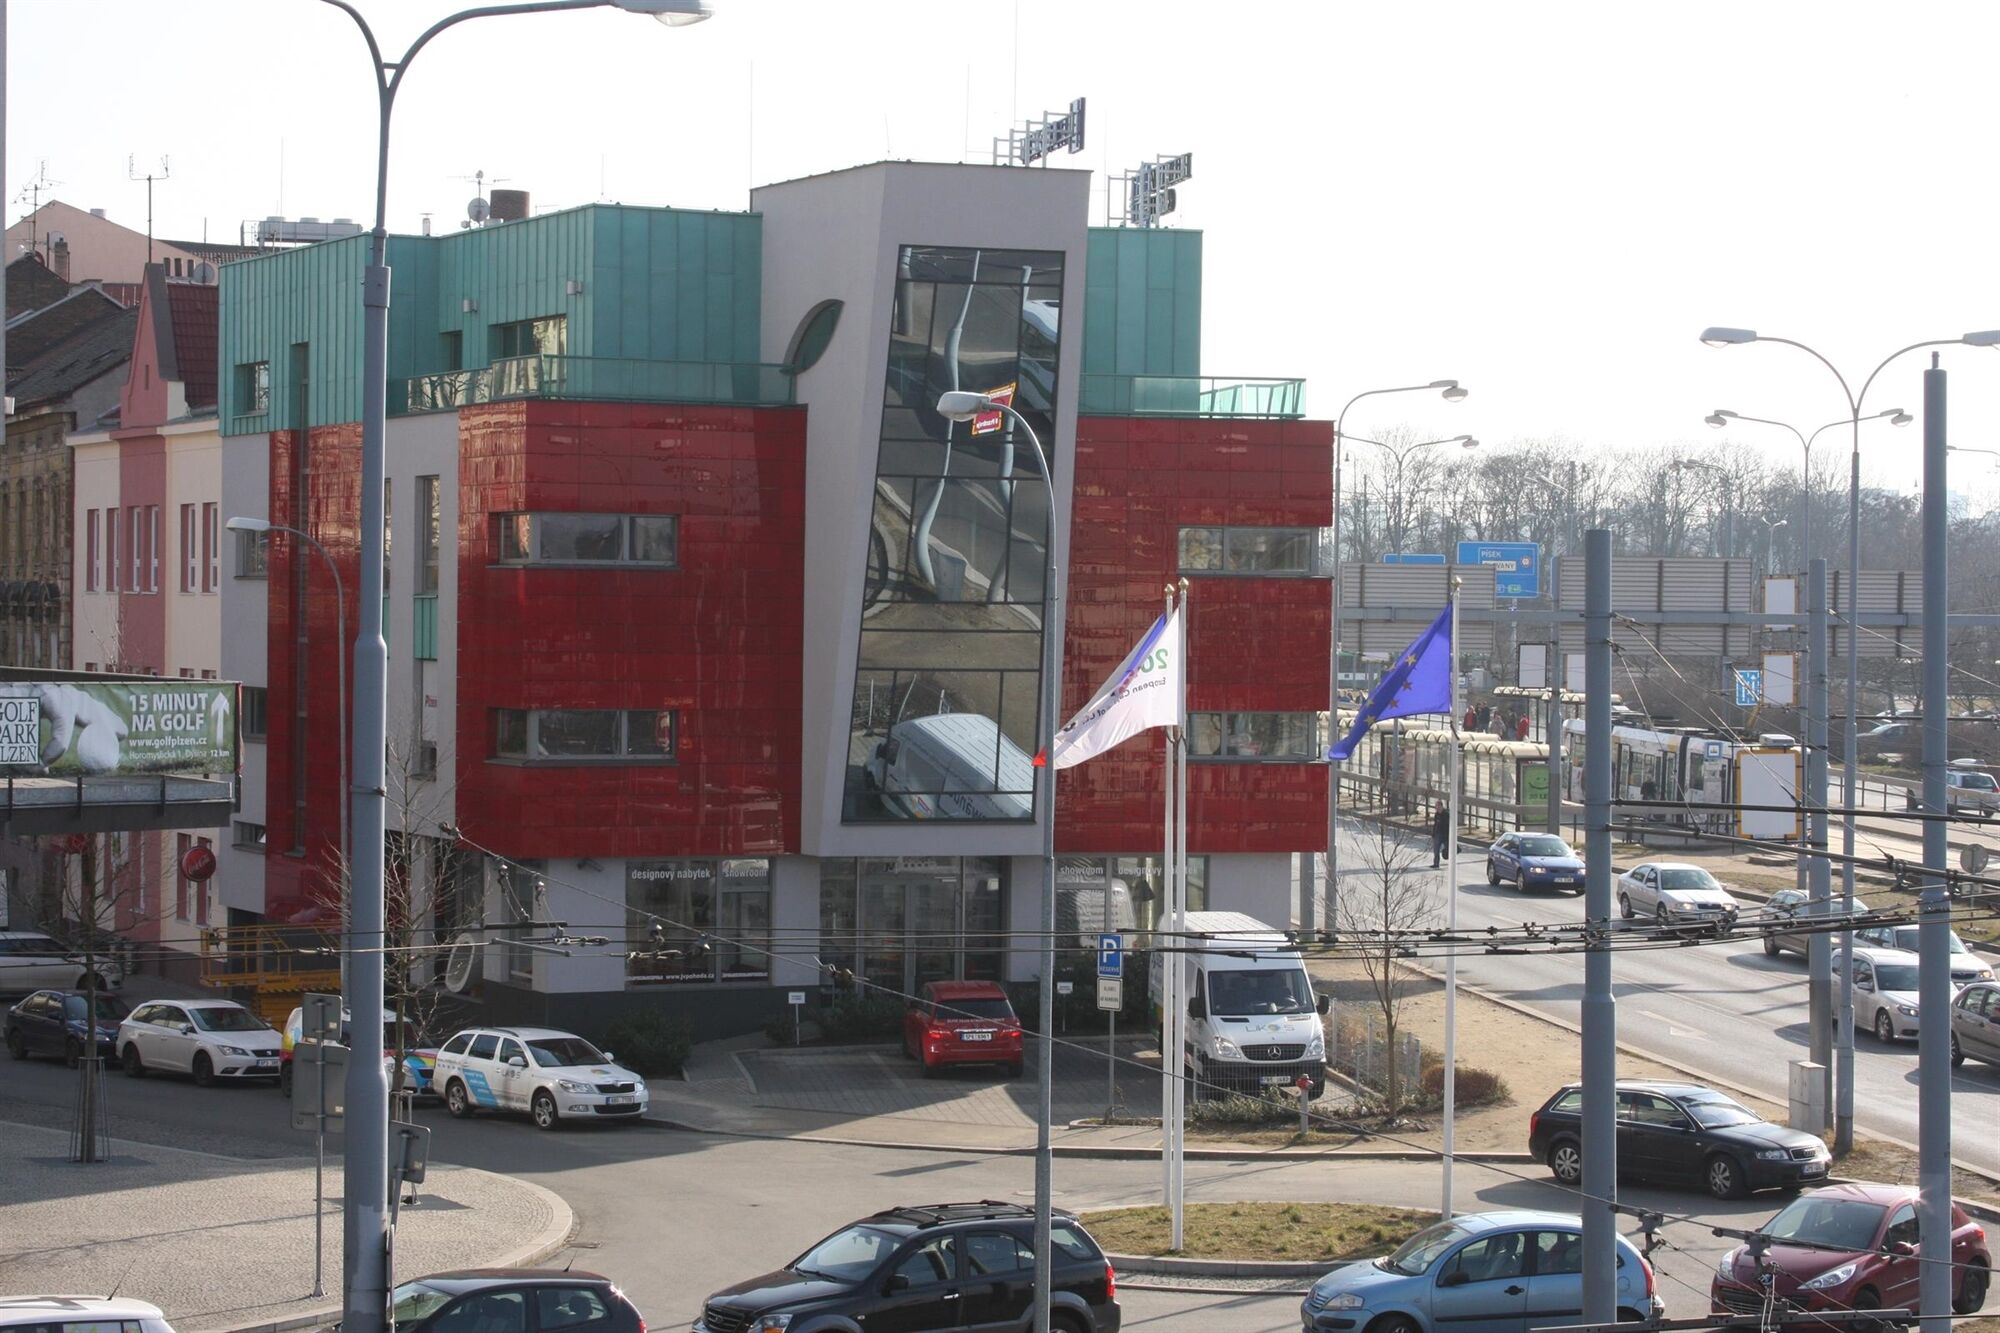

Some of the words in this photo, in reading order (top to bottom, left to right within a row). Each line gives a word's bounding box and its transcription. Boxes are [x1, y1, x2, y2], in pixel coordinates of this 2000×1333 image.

[129, 694, 148, 712] 15
[153, 693, 208, 711] MINUT
[132, 714, 156, 732] NA
[160, 713, 204, 731] GOLF
[0, 724, 36, 744] ARK
[129, 736, 207, 748] www.golfplzen.cz
[1060, 865, 1103, 875] showroom
[1103, 938, 1117, 963] P
